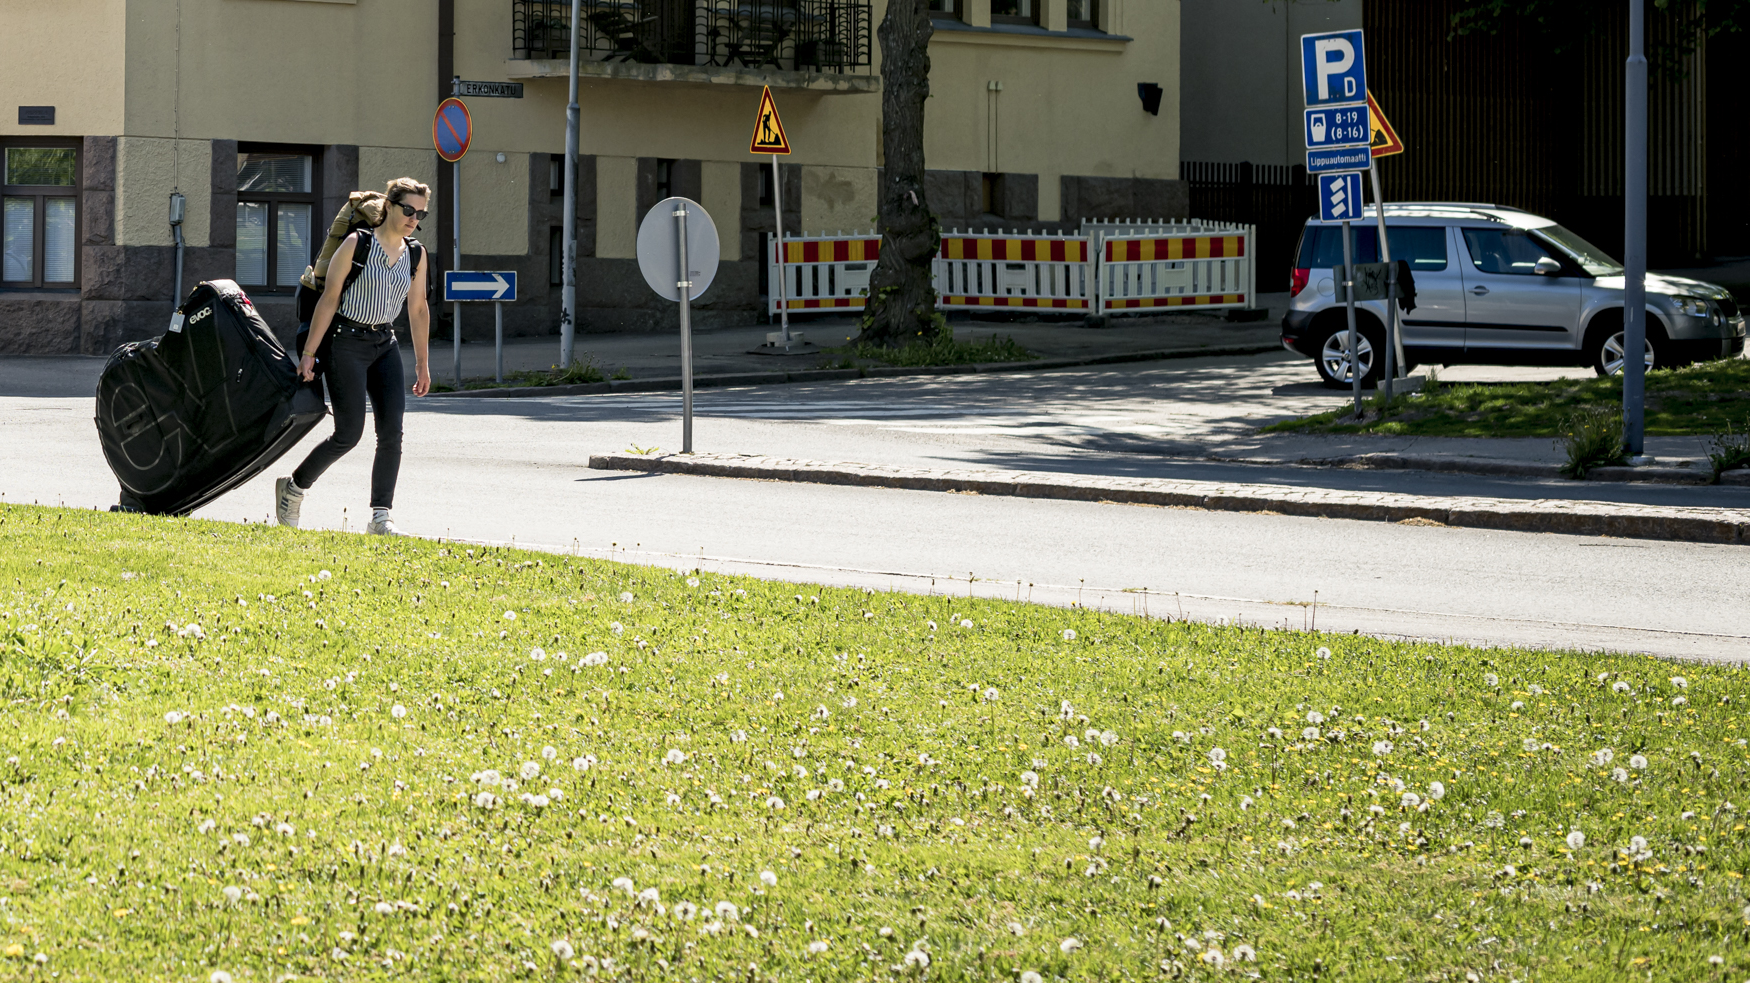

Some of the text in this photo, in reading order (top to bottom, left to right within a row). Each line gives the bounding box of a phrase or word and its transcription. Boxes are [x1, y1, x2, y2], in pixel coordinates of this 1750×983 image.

[1315, 37, 1357, 100] P D
[466, 83, 516, 96] ERKONKATU
[1335, 111, 1358, 124] 8-19
[1331, 125, 1364, 140] (8-16)
[1310, 152, 1367, 167] Lippuautomaatti
